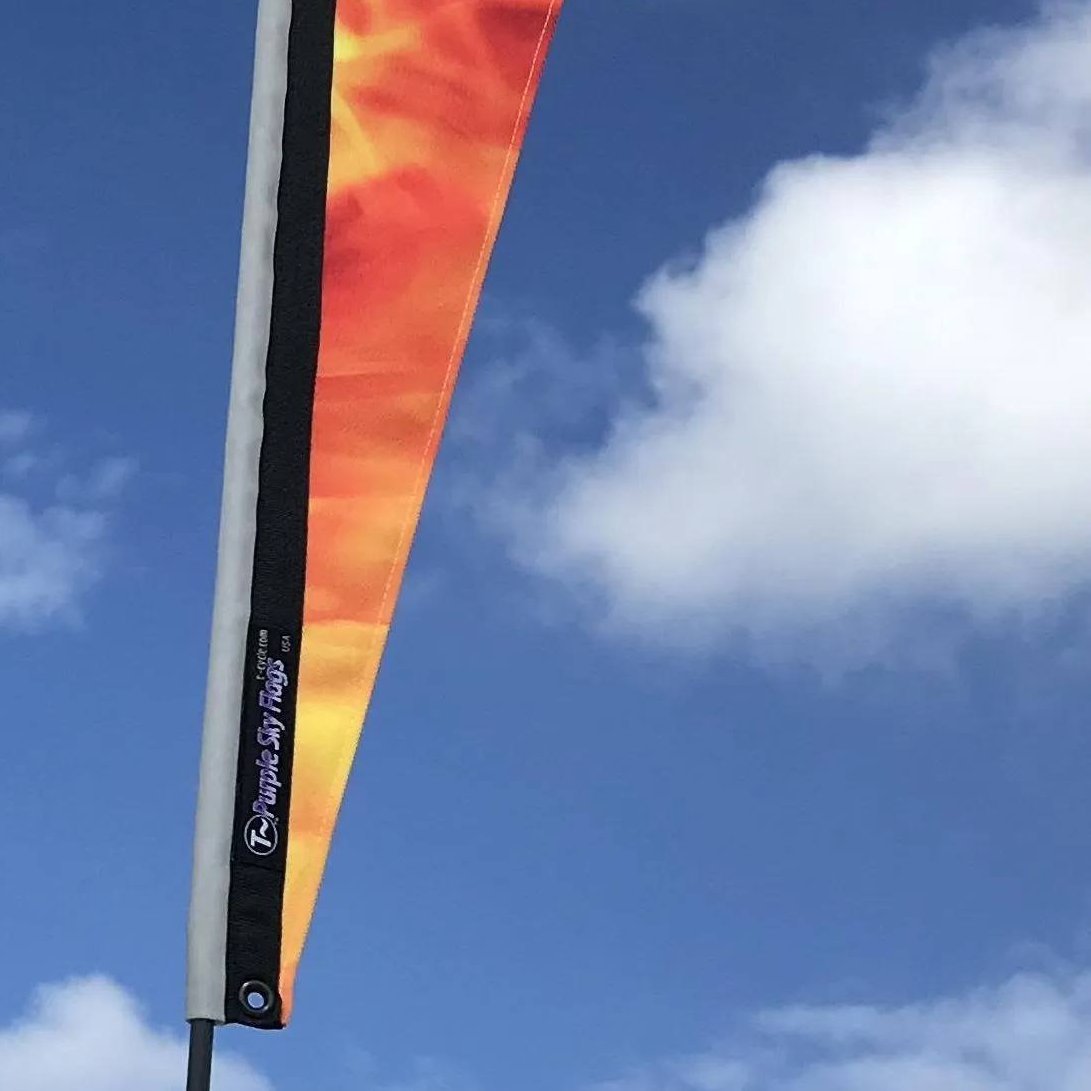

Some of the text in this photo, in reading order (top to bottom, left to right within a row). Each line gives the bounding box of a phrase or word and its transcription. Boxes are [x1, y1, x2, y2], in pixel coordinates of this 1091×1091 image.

[281, 635, 292, 653] USA
[259, 657, 289, 713] Flags
[256, 713, 286, 750] Sky
[252, 749, 282, 818] Purple
